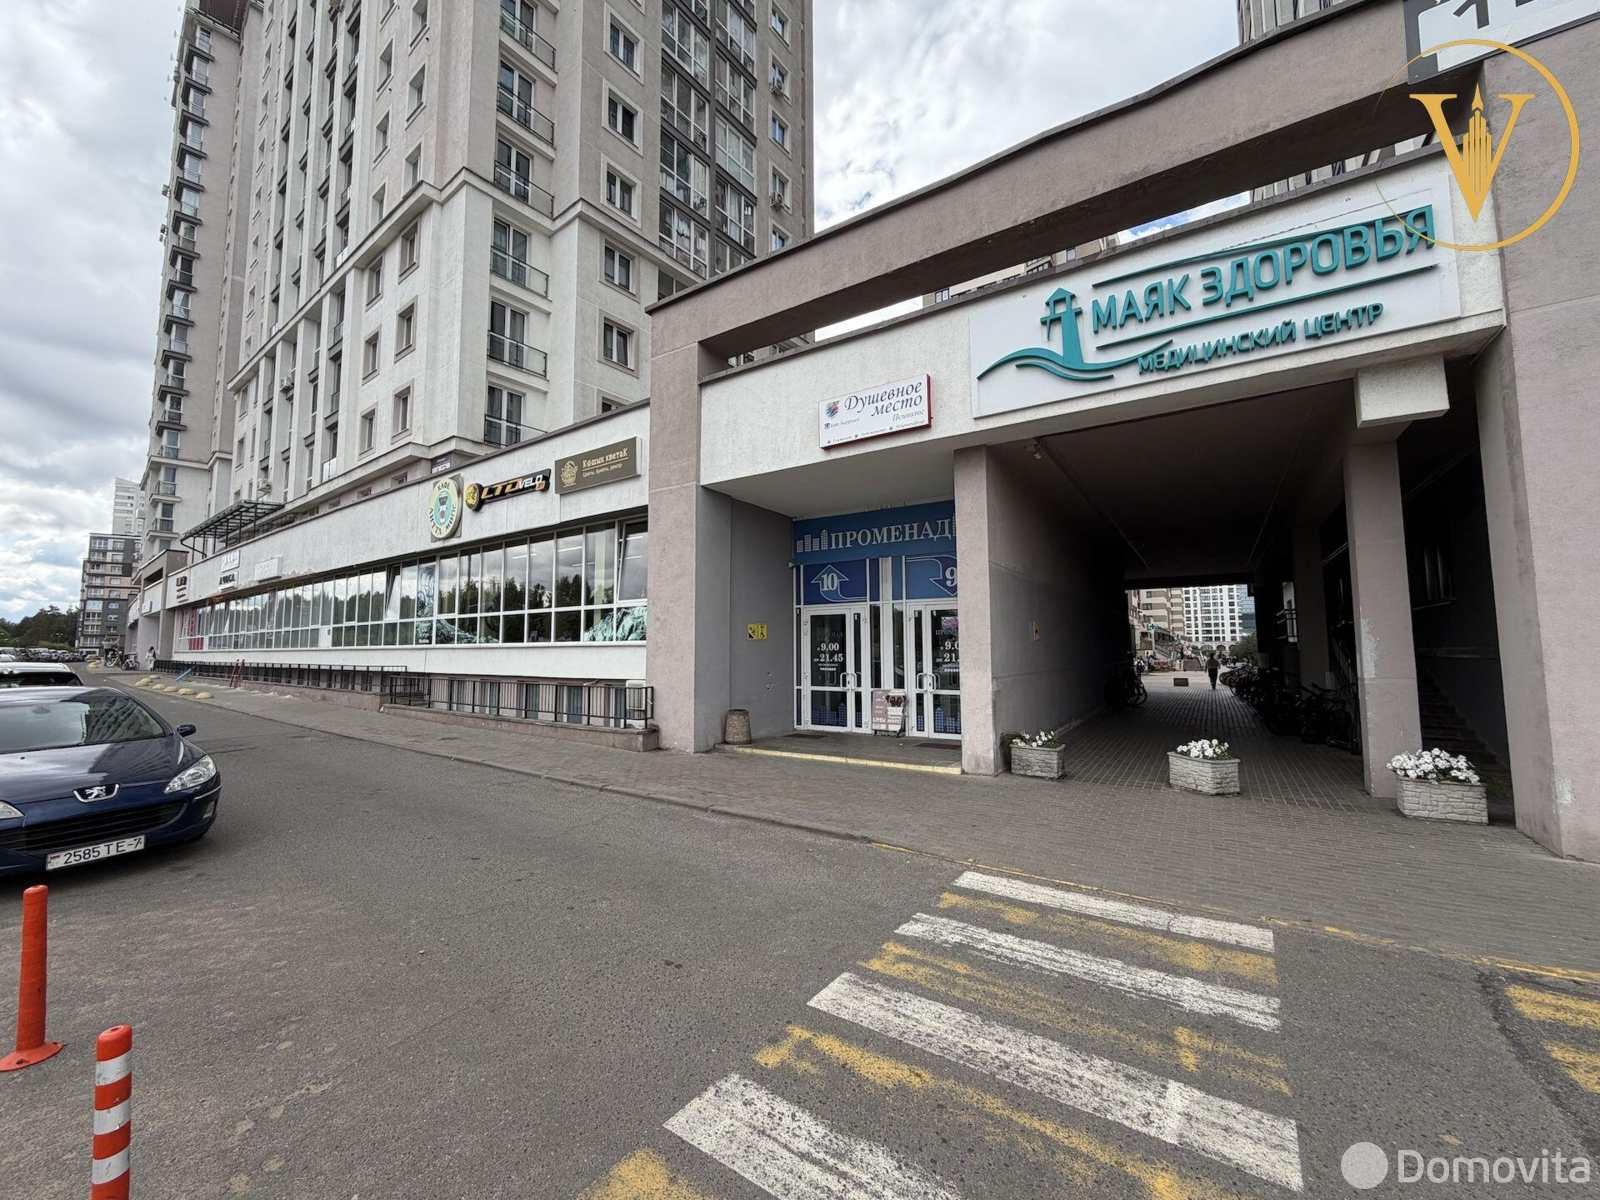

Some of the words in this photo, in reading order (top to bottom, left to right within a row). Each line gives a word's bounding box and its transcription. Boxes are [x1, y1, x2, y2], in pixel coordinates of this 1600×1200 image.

[1092, 273, 1192, 333] МАЯК
[1202, 204, 1436, 306] ЗДОРОВЬЯ
[1138, 319, 1297, 375] МЕДИЦИНСКИЙ
[1304, 302, 1384, 341] ЦЕНТР
[844, 381, 922, 413] Душевное
[871, 395, 923, 417] место
[437, 481, 451, 491] КАФЕ
[481, 477, 524, 500] LTD
[518, 474, 543, 489] VELO
[830, 518, 951, 549] ПРОМЕНАД
[821, 572, 838, 591] 10
[944, 566, 958, 587] 9
[819, 653, 844, 662] 21.45
[820, 642, 840, 652] 9.00
[63, 845, 101, 865] 2585
[104, 837, 142, 856] TE-7
